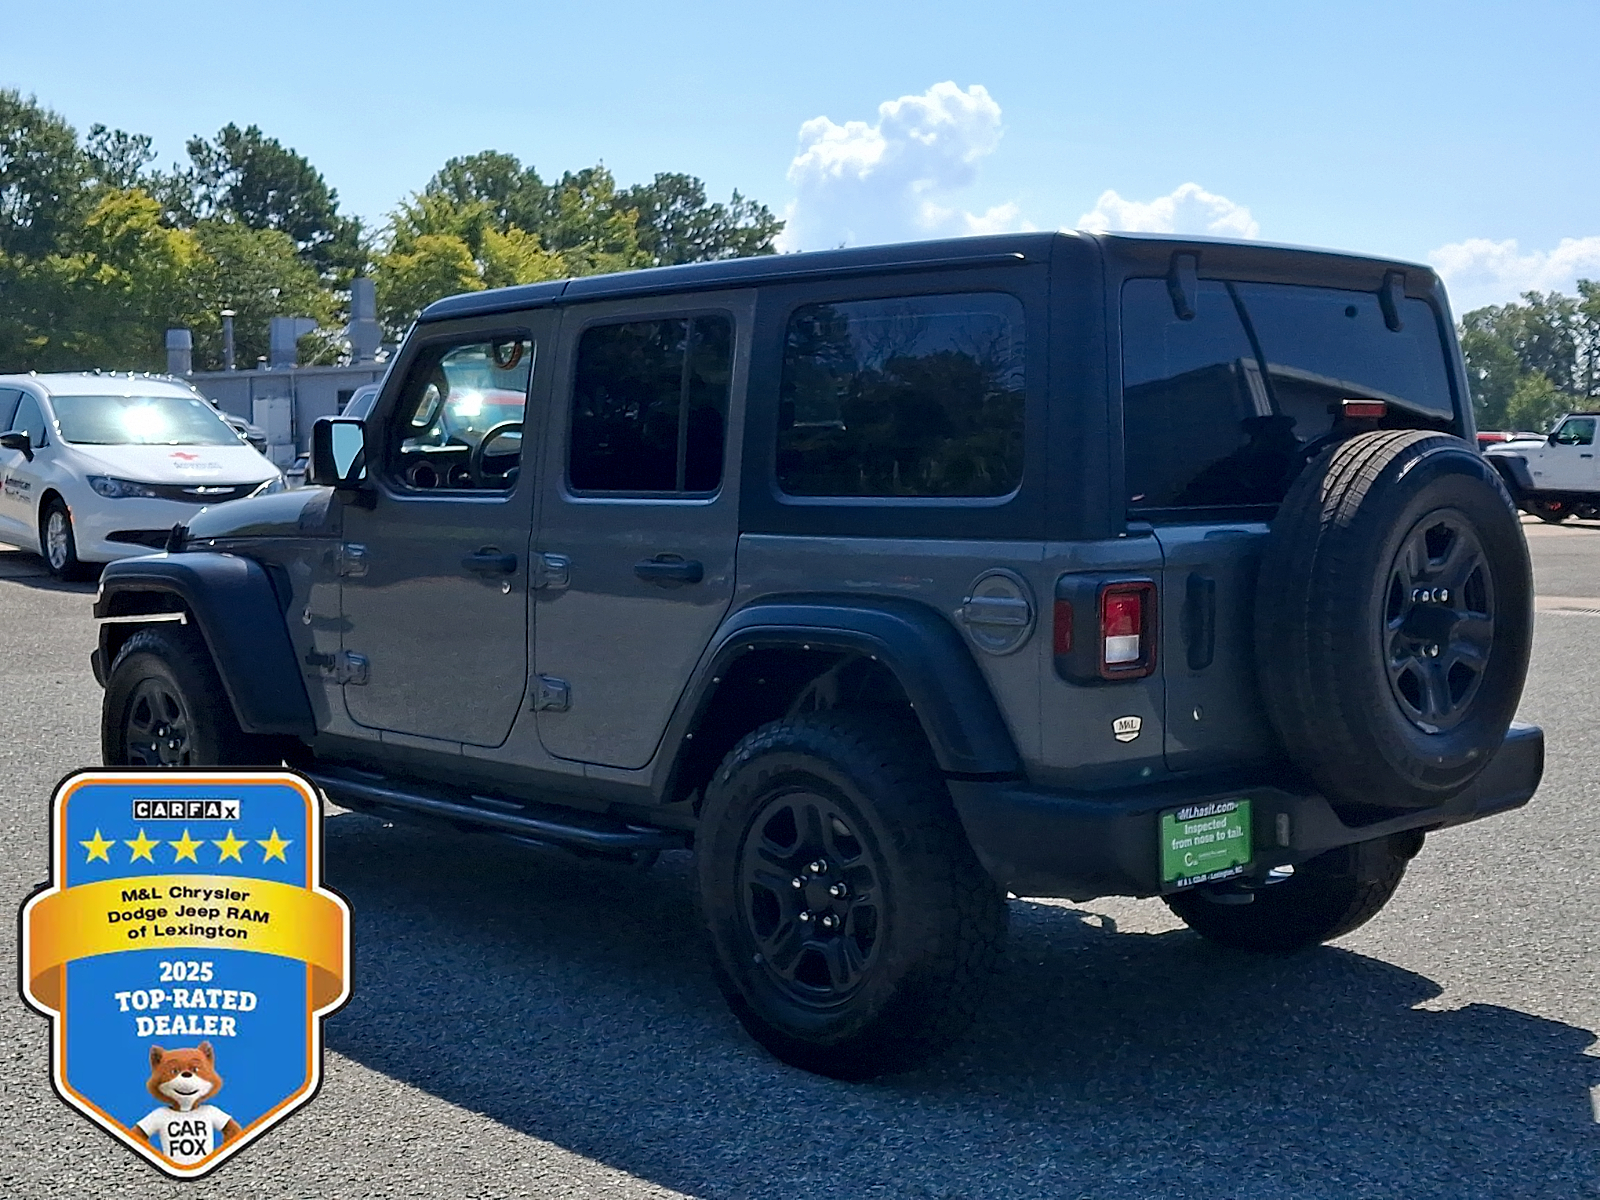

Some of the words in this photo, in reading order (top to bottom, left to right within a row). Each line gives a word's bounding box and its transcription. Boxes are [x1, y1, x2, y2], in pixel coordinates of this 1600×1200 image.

[1184, 816, 1227, 835] Inspected
[1171, 837, 1193, 850] from
[1194, 833, 1215, 846] nose
[1216, 831, 1226, 841] to
[1227, 825, 1244, 839] tail.
